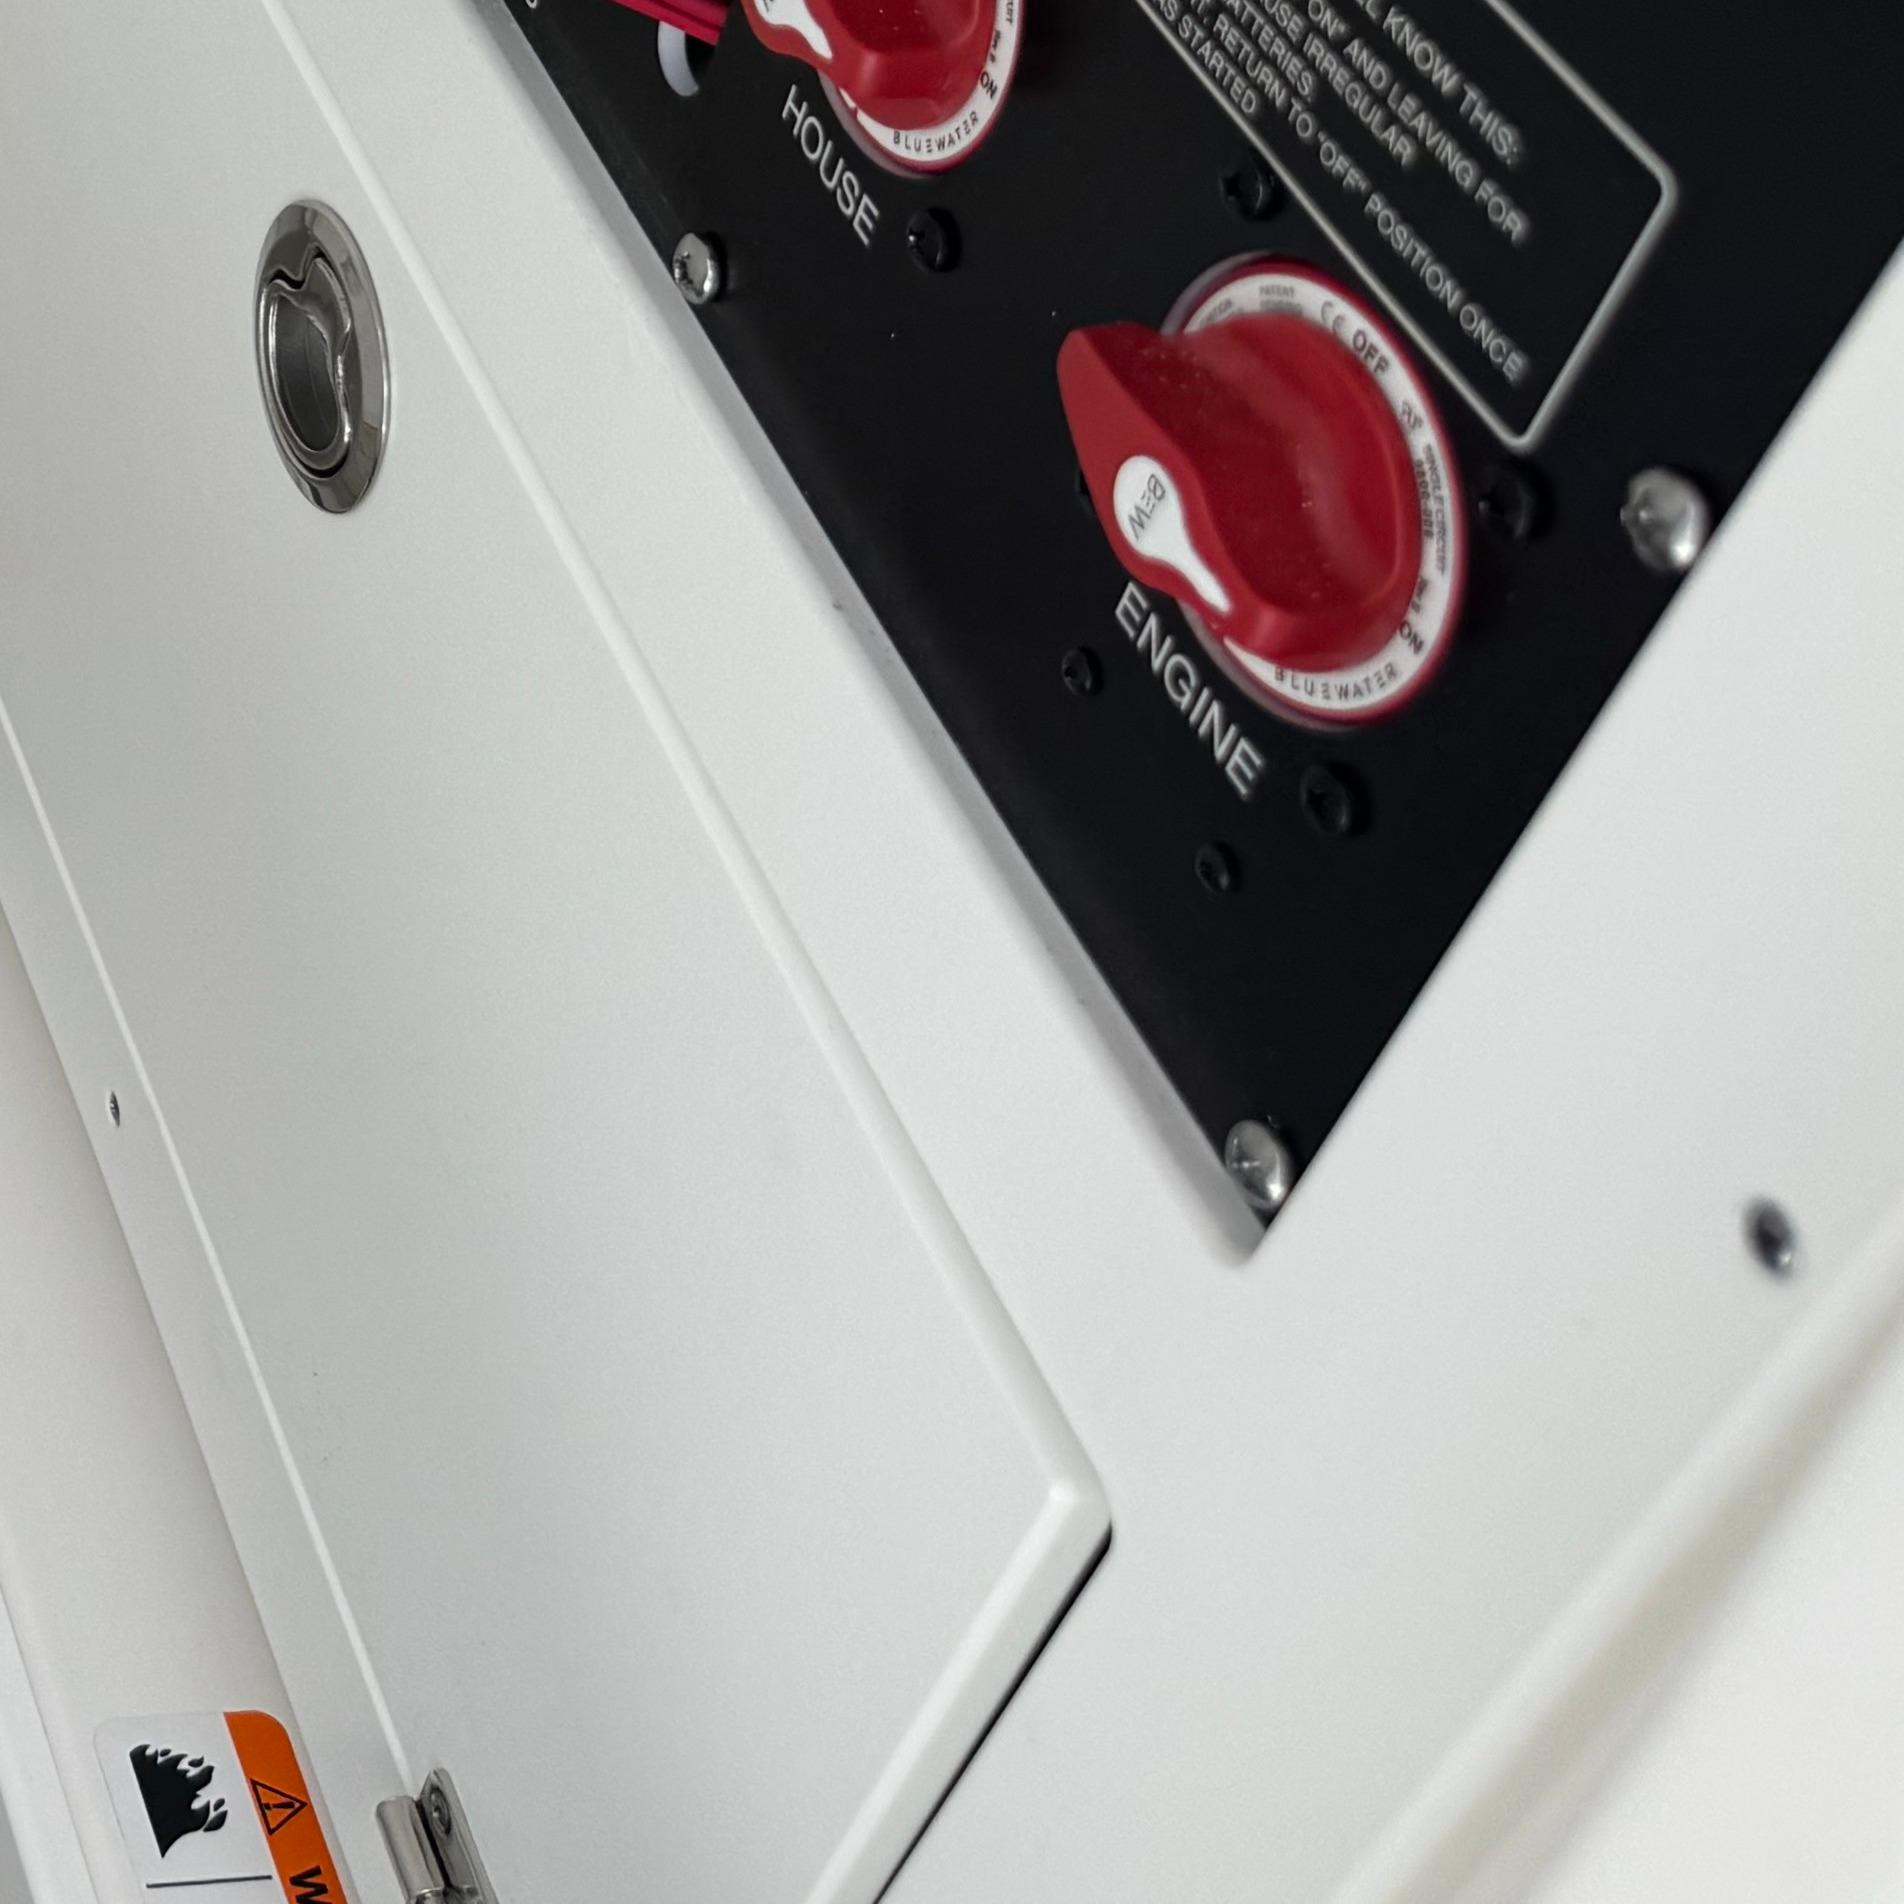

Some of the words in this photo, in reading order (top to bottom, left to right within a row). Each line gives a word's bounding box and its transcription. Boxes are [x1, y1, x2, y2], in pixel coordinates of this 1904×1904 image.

[979, 70, 1000, 100] ON
[1177, 21, 1259, 117] STARTED
[1382, 6, 1462, 96] KNOW
[892, 110, 980, 156] BLUEWATER
[1302, 32, 1419, 169] IRREGULAR
[1343, 35, 1390, 92] AND
[1387, 79, 1481, 193] LEAVING
[1473, 179, 1533, 246] FOR
[781, 83, 880, 248] HOUSE
[1212, 17, 1289, 108] RETURN
[1286, 97, 1317, 139] TO
[1363, 193, 1464, 315] POSITION
[1458, 301, 1531, 387] ONCE
[1352, 329, 1391, 378] OFF
[1274, 660, 1399, 703] BLUEWATER
[1397, 622, 1424, 655] ON
[1113, 580, 1268, 802] ENGINE
